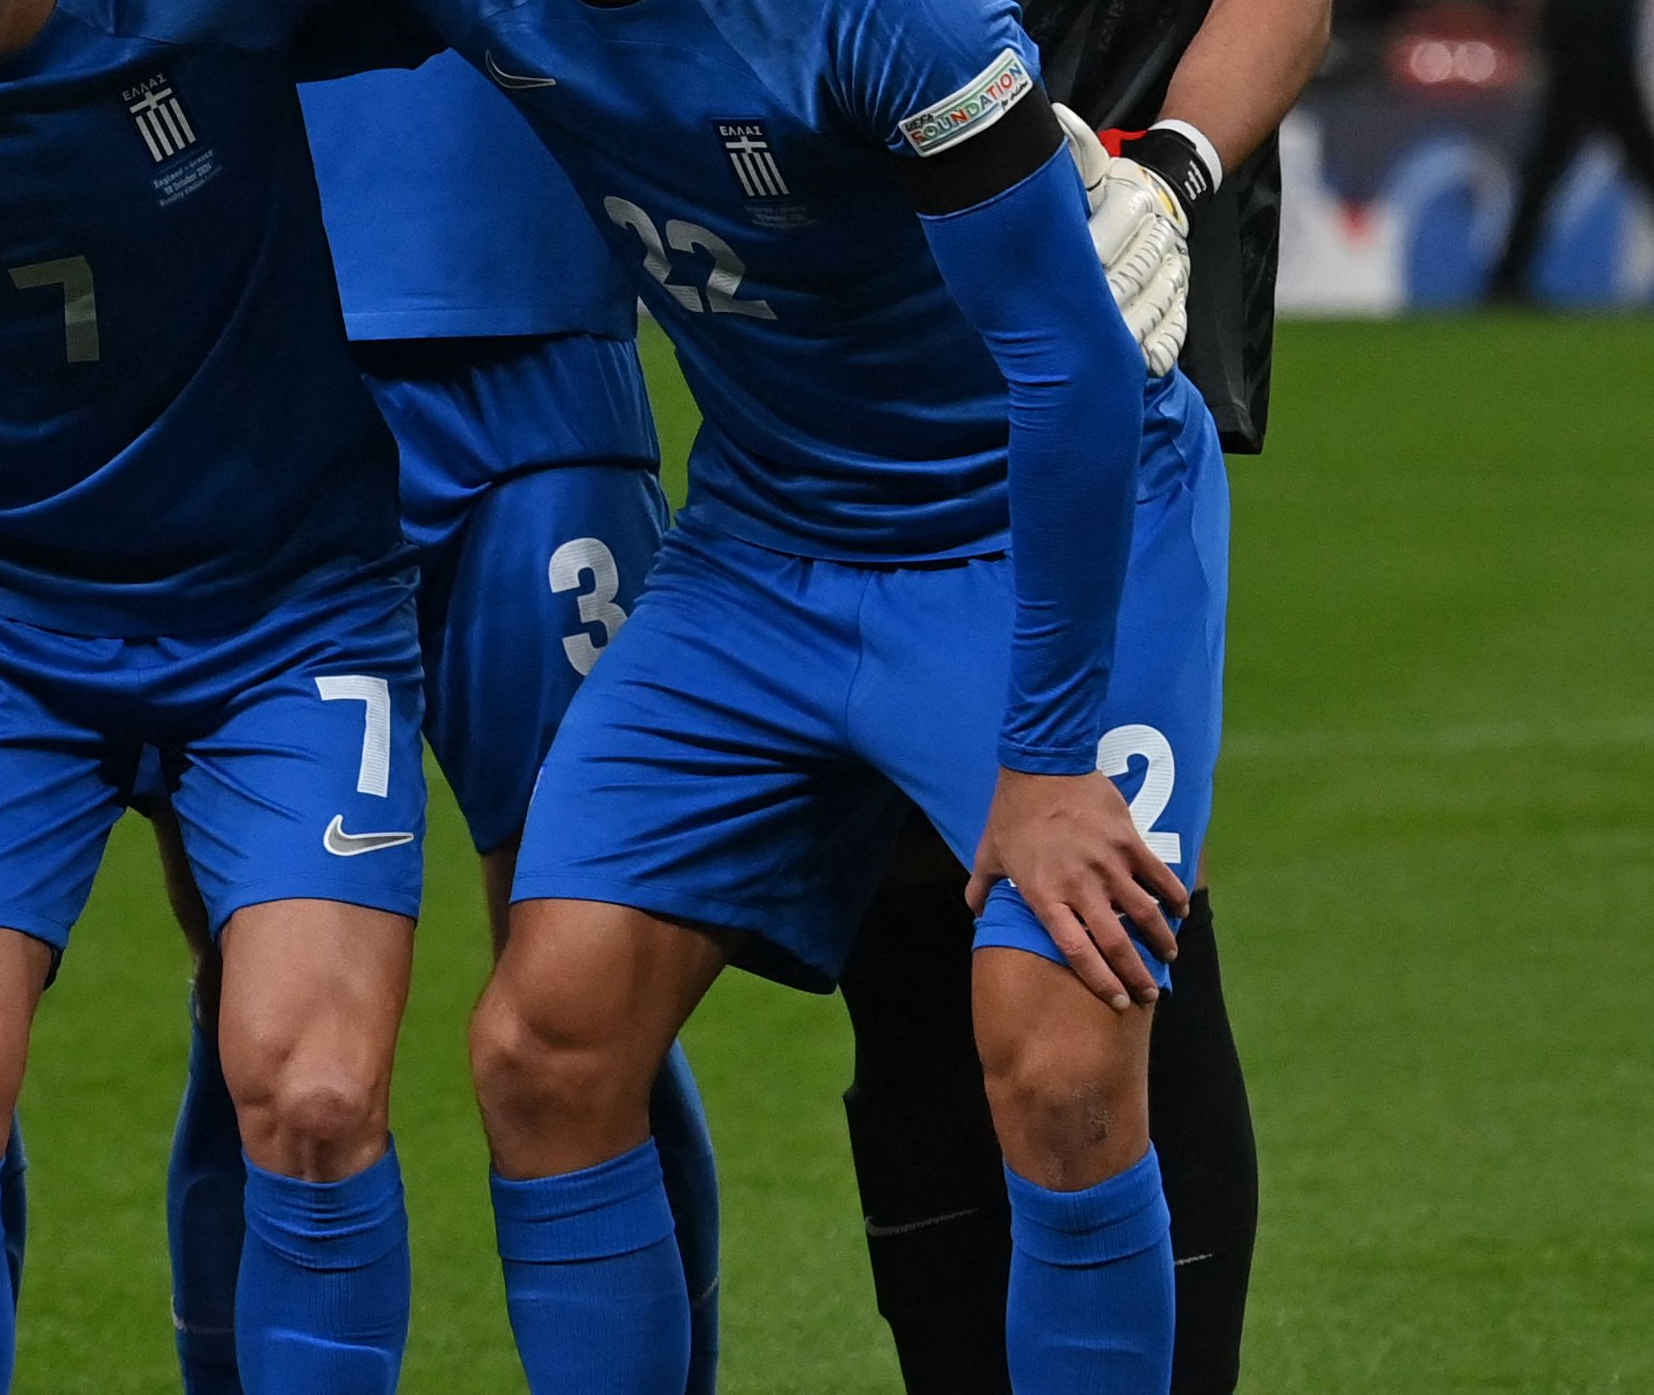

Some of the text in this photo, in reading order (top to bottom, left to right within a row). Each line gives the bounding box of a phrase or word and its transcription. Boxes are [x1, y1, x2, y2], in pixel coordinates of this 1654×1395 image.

[122, 72, 167, 101] ΕΛΛΑΣ
[719, 125, 763, 136] ΕΛΛΑΣ
[905, 112, 935, 132] UEFA
[910, 62, 1023, 144] FOUNDATION
[603, 195, 779, 320] 22
[7, 255, 100, 363] 7
[548, 537, 628, 676] 3
[315, 675, 390, 797] 7
